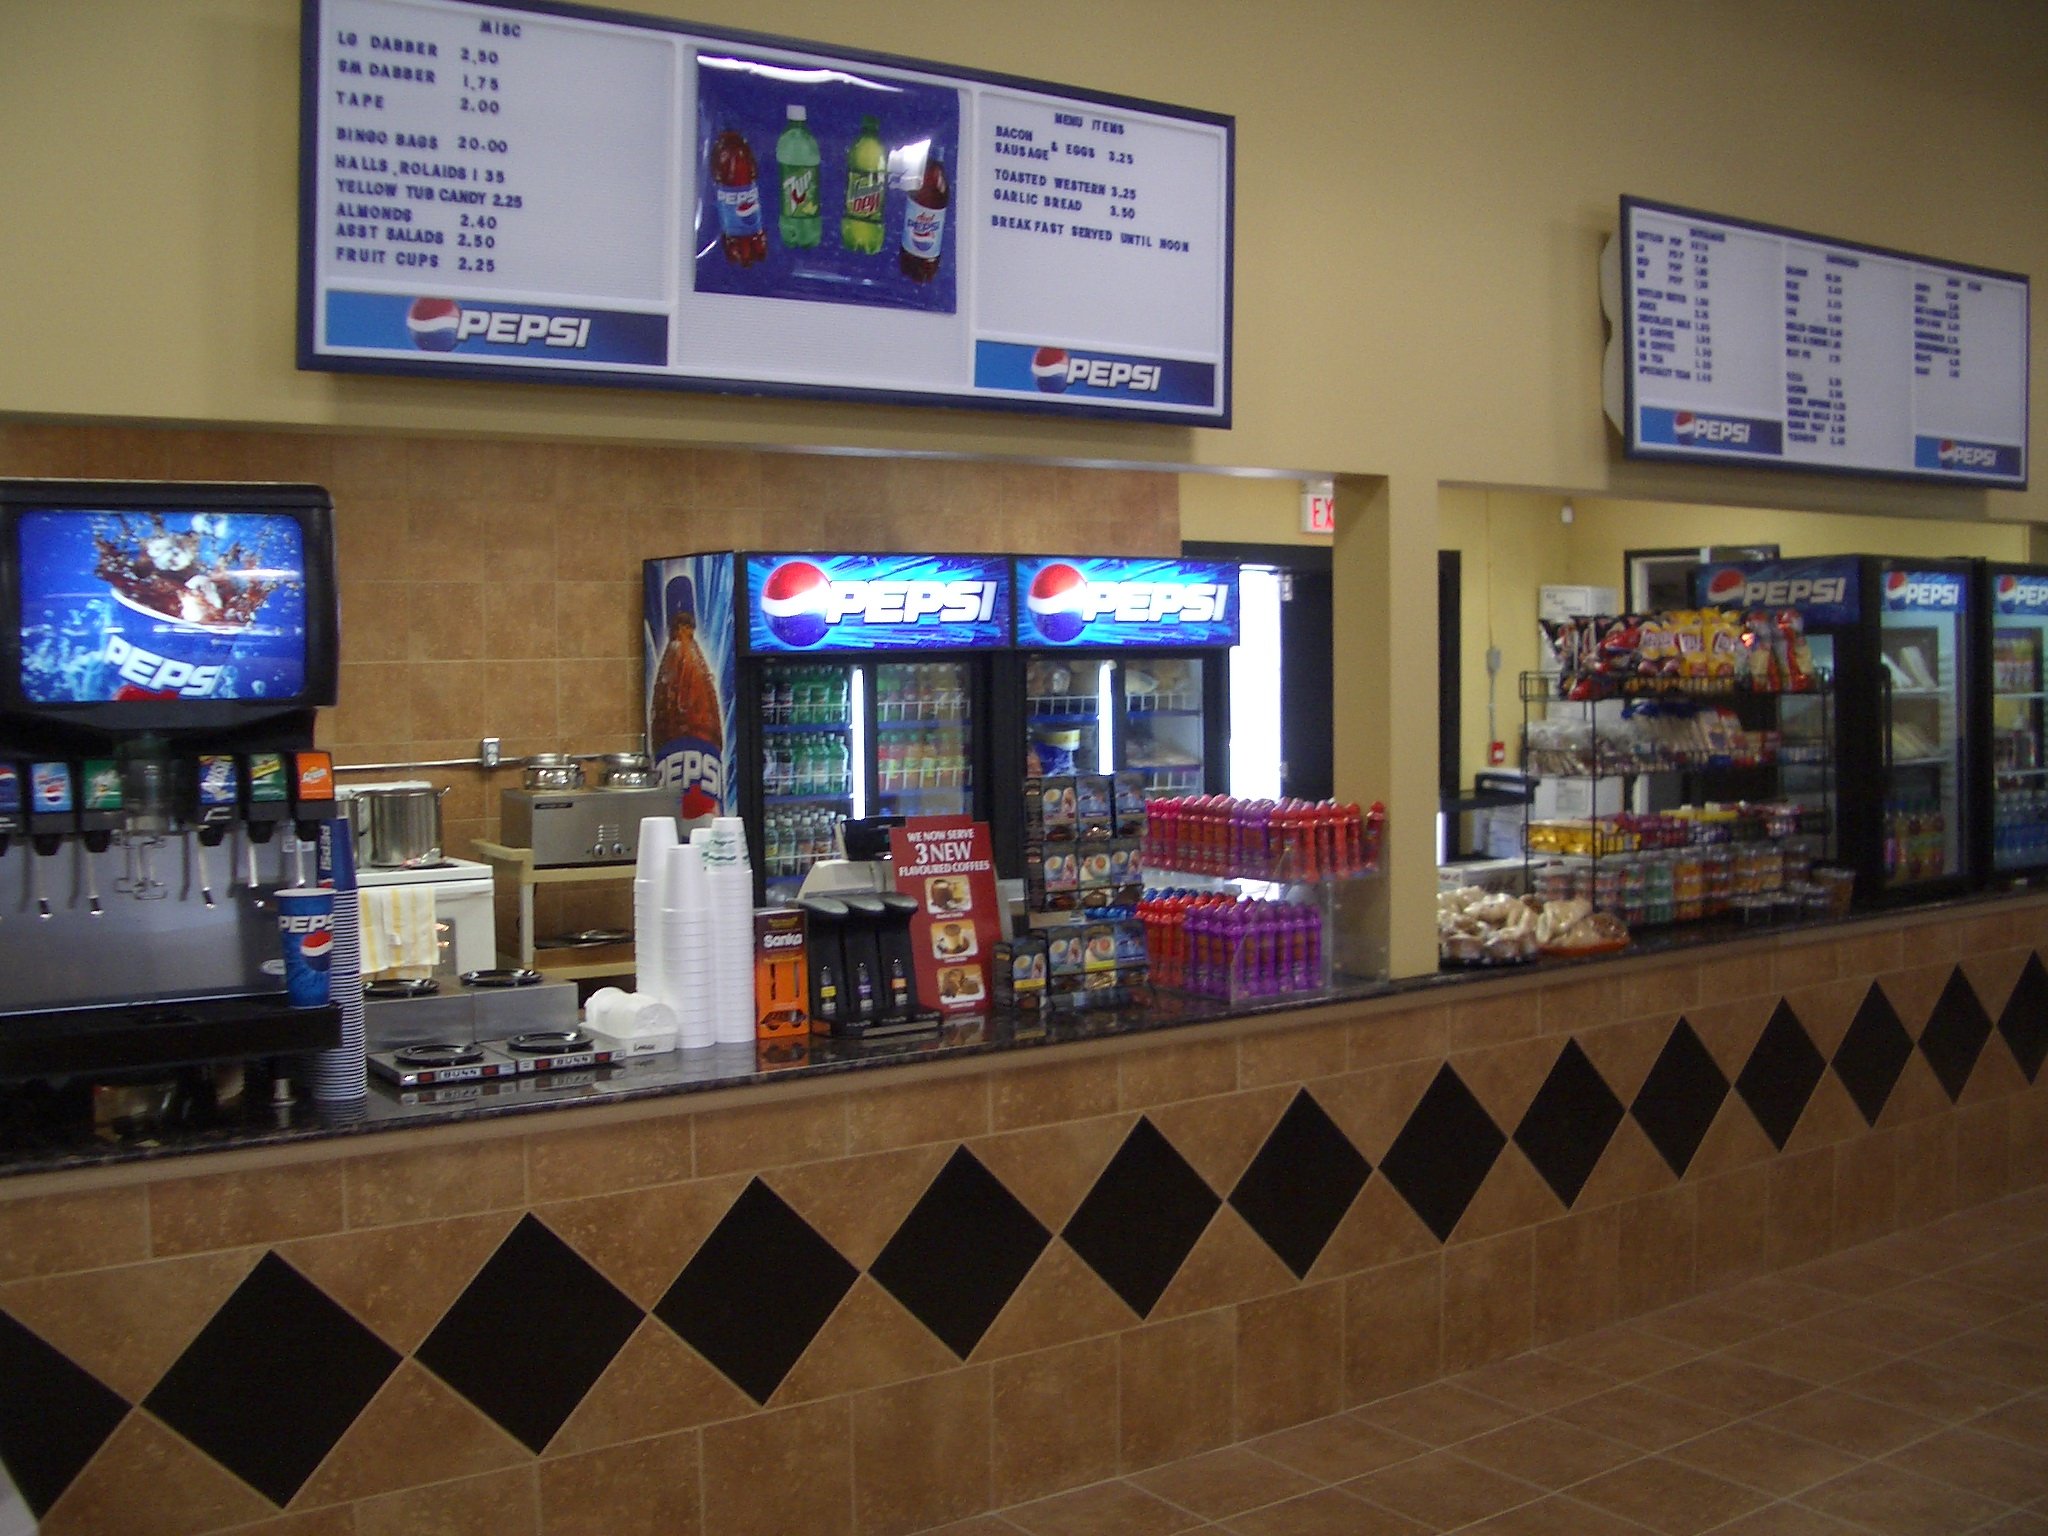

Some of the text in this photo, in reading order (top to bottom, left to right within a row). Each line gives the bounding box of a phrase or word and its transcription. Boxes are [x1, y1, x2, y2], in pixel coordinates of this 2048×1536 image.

[480, 19, 521, 38] MISC
[370, 35, 438, 57] DABBER
[369, 62, 436, 84] DABBER
[336, 90, 499, 114] TAPE 2.00
[996, 126, 1033, 142] BACON
[1054, 113, 1125, 136] MENU ITEMS
[336, 126, 507, 153] BINGO BAGS 20.00
[995, 142, 1049, 161] SAUSAGE
[1066, 143, 1095, 159] EGGS
[335, 178, 397, 198] YELLOW
[405, 185, 434, 201] TUB
[439, 188, 487, 205] CANDY
[994, 168, 1046, 187] TOASTED
[1054, 176, 1106, 196] WESTERN
[994, 188, 1038, 205] GARLIC
[1044, 195, 1082, 211] BREAD
[335, 203, 497, 229] ALMONDS 2.40
[335, 223, 495, 248] ASST SALADS 2.50
[1071, 225, 1112, 241] SERVED
[1120, 232, 1152, 248] UNTIL
[1159, 238, 1190, 252] NOON
[335, 247, 495, 273] FRUIT CUPS 2.25
[456, 309, 592, 348] PEPSI
[1066, 358, 1162, 392] PEPSI
[1695, 418, 1751, 443] PEPSI
[1952, 445, 1998, 467] PEPSI
[1311, 498, 1334, 529] EX
[824, 579, 997, 625] PEPSI
[1080, 581, 1228, 623] PEPSI
[1743, 577, 1847, 607] PEPSI
[1905, 583, 1960, 605] PEPSI
[2015, 585, 2048, 606] PEP
[104, 634, 225, 697] PEPS
[906, 828, 975, 843] WE NOW SERVE
[914, 840, 973, 865] 3 NEW
[278, 913, 334, 933] PEPS
[763, 931, 803, 948] Sanka
